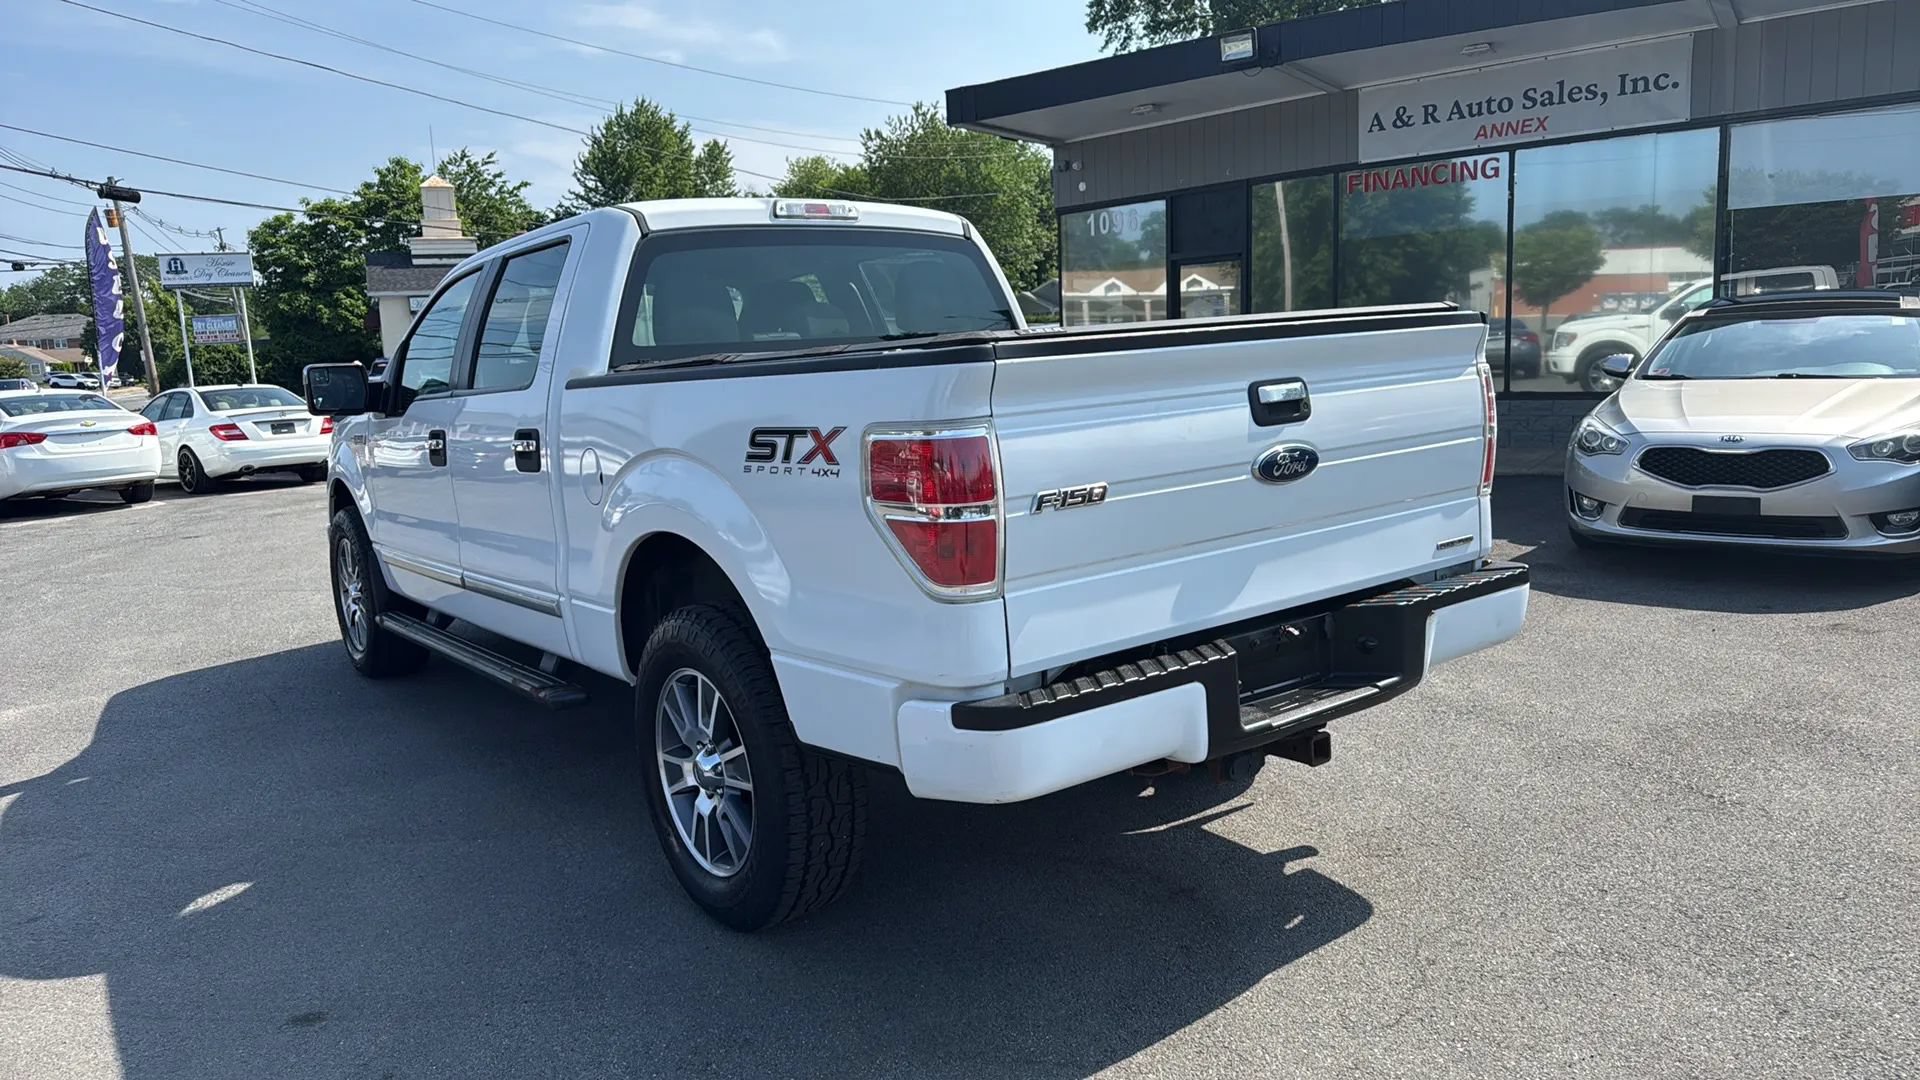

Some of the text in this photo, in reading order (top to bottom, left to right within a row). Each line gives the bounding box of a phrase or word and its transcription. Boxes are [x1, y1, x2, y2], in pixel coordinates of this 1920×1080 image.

[1368, 72, 1680, 133] A & R Auto Sales, Inc.
[1474, 116, 1549, 141] ANNEX
[1347, 157, 1500, 194] FINANCING
[193, 268, 213, 281] Dry
[215, 267, 250, 278] Cleaners
[745, 426, 848, 465] STX
[743, 465, 806, 476] SPORT
[1272, 451, 1309, 477] Ford
[1030, 481, 1109, 516] F-150
